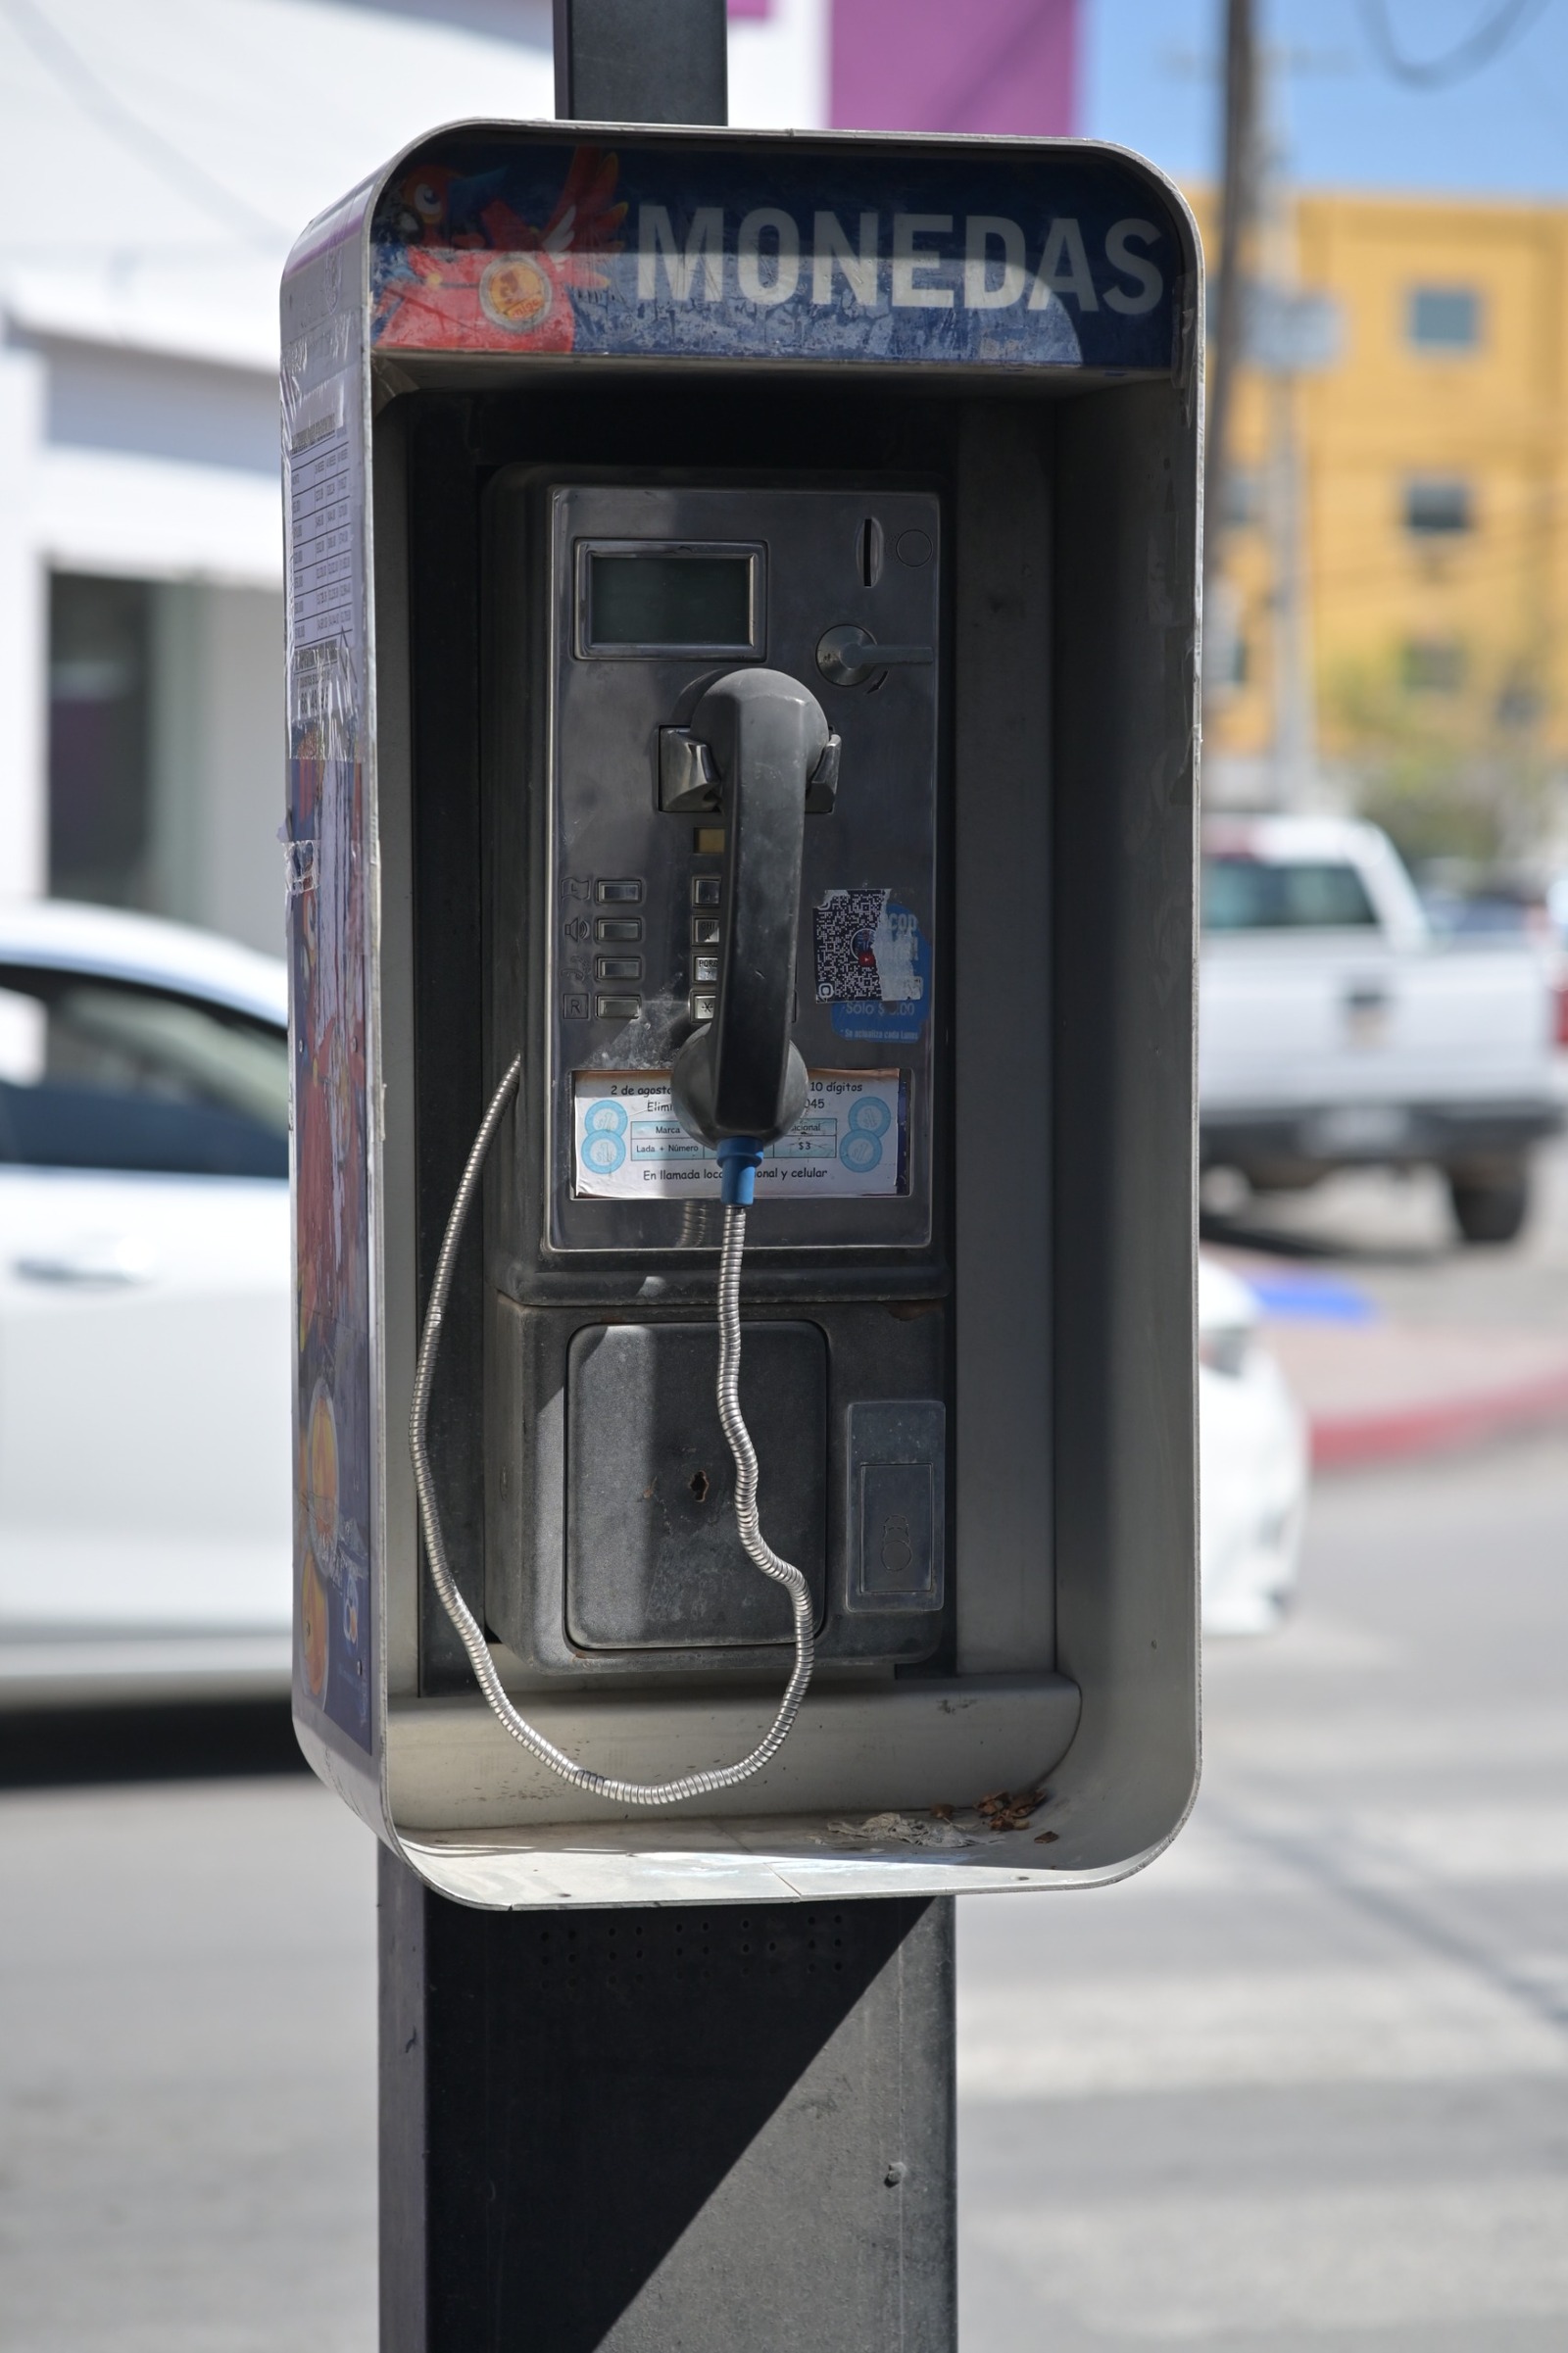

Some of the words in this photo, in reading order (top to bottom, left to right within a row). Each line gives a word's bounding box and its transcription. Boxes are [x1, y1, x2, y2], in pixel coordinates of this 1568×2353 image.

[637, 204, 1163, 315] MONEDAS
[570, 1000, 580, 1013] R
[611, 1085, 617, 1095] 2
[621, 1085, 634, 1096] de
[810, 1081, 823, 1092] 10
[826, 1081, 862, 1095] dígitos
[648, 1101, 673, 1112] Elimi
[668, 1144, 699, 1152] Número
[643, 1170, 656, 1180] En
[661, 1170, 700, 1180] llamada
[782, 1170, 788, 1180] y
[791, 1167, 827, 1178] celular
